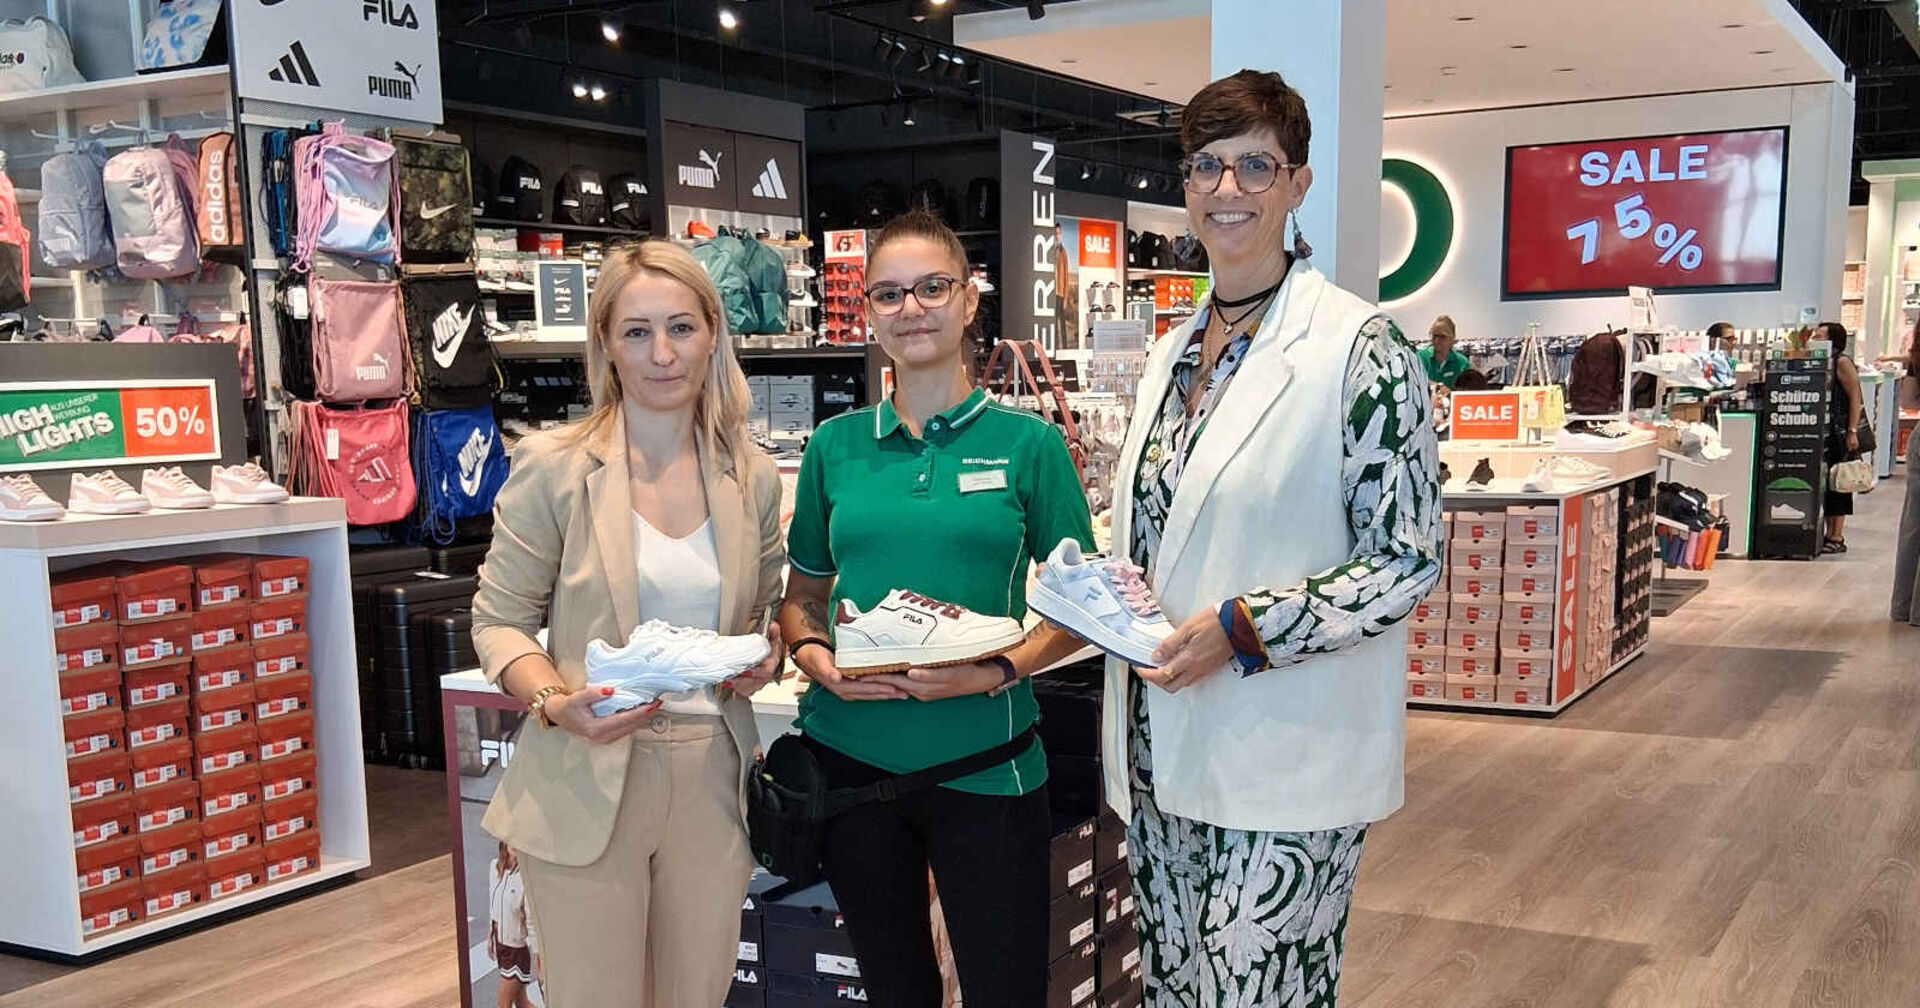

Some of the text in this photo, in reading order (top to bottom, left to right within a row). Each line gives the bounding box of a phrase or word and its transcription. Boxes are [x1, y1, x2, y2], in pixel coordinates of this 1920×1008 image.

[362, 0, 419, 30] FILA
[368, 75, 413, 101] PUMA
[678, 164, 715, 188] PUMA
[1579, 144, 1709, 187] SALE
[519, 177, 541, 190] FILA
[581, 181, 604, 195] FILA
[626, 182, 648, 195] FILA
[206, 149, 227, 243] adidas
[1032, 141, 1056, 359] ERREN
[1084, 234, 1111, 253] SALE
[1770, 390, 1820, 404] Schütze
[136, 406, 205, 439] 50%
[1459, 404, 1514, 421] SALE
[1769, 412, 1818, 426] Schuhe
[16, 411, 115, 458] LIGHTS
[1561, 522, 1578, 673] SALE
[903, 613, 923, 625] FILA
[481, 739, 515, 769] FI
[732, 968, 758, 984] ILA
[836, 981, 869, 1002] FILA
